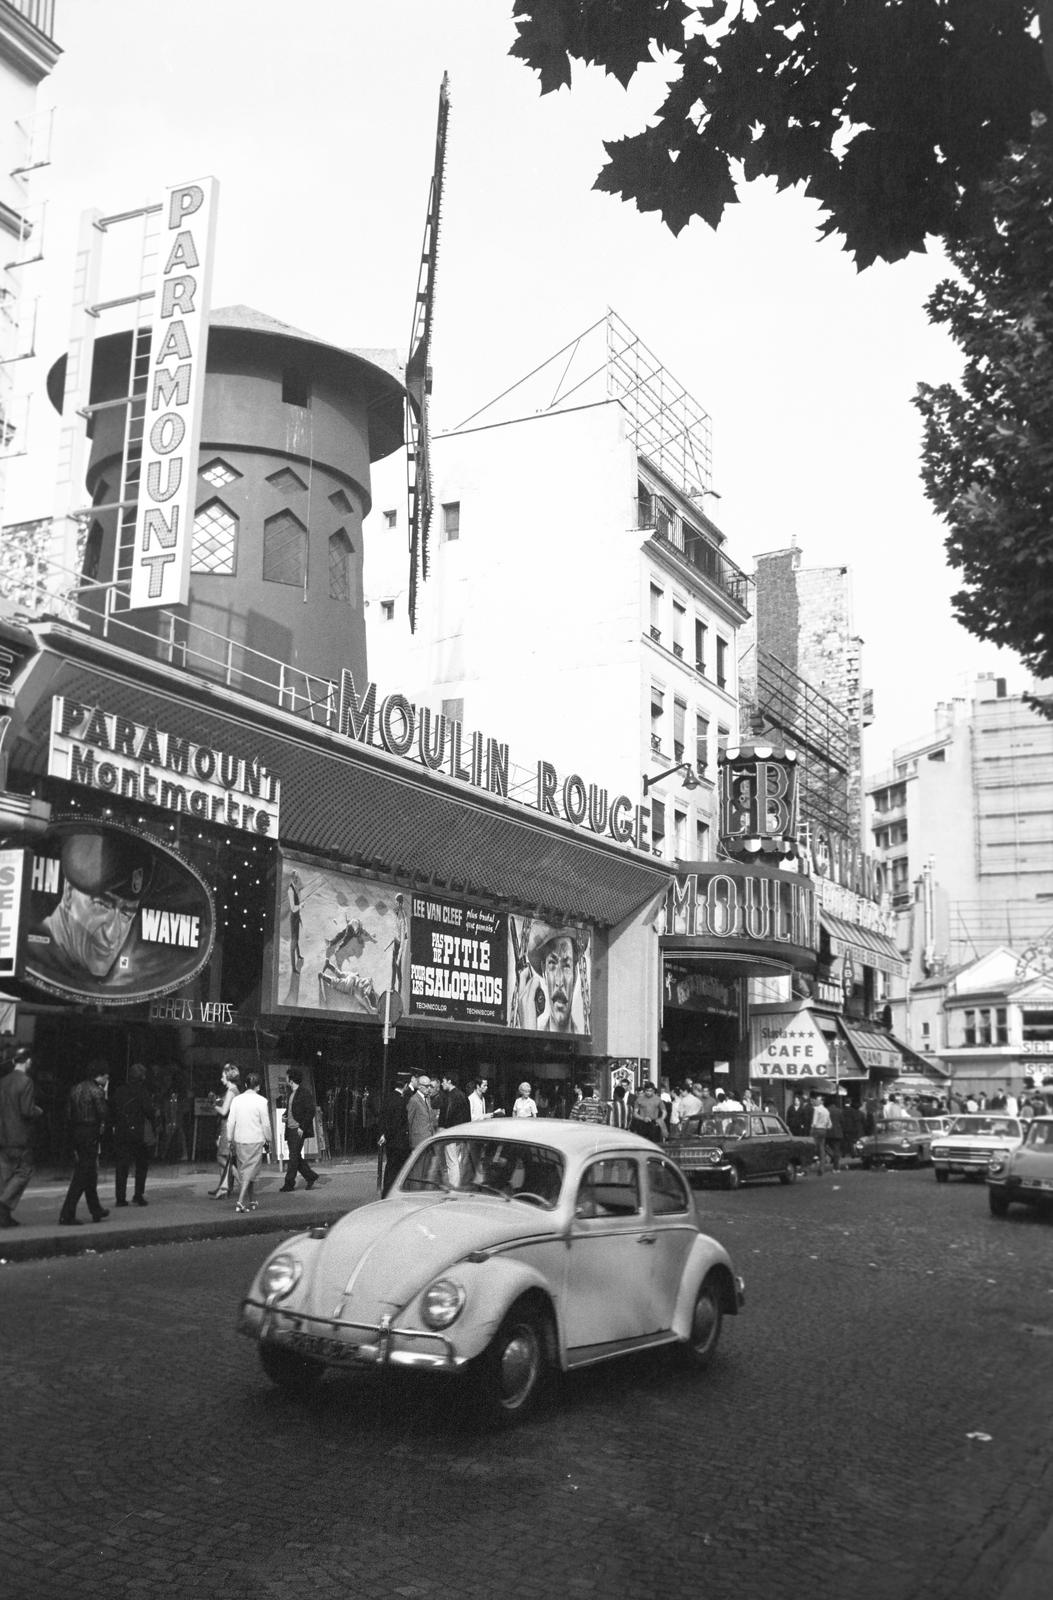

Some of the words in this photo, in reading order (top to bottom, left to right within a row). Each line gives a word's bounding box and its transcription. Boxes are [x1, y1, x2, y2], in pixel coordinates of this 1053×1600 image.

[141, 184, 204, 598] PARAMOUNT
[61, 696, 281, 804] PARAMOUNT
[339, 668, 509, 797] MOULIN
[537, 760, 651, 852] ROUGE
[71, 743, 271, 834] Montmartre
[413, 899, 426, 918] LEE
[426, 902, 442, 922] VAN
[442, 906, 463, 926] CLEEF
[465, 908, 478, 921] plus
[664, 873, 812, 948] MOULIN
[142, 908, 200, 948] WAYNE
[431, 932, 444, 948] PAS
[432, 948, 443, 964] DE
[443, 934, 491, 971] PITIÉ
[410, 964, 426, 981] POUR
[411, 980, 424, 995] LES
[424, 966, 503, 1005] SALOPARDS
[844, 950, 853, 996] TABAC
[200, 1001, 234, 1025] VERTS
[416, 1001, 448, 1012] TECHNICOLOR
[466, 1007, 496, 1017] TECHNISCOPE
[759, 1063, 828, 1076] TABAC
